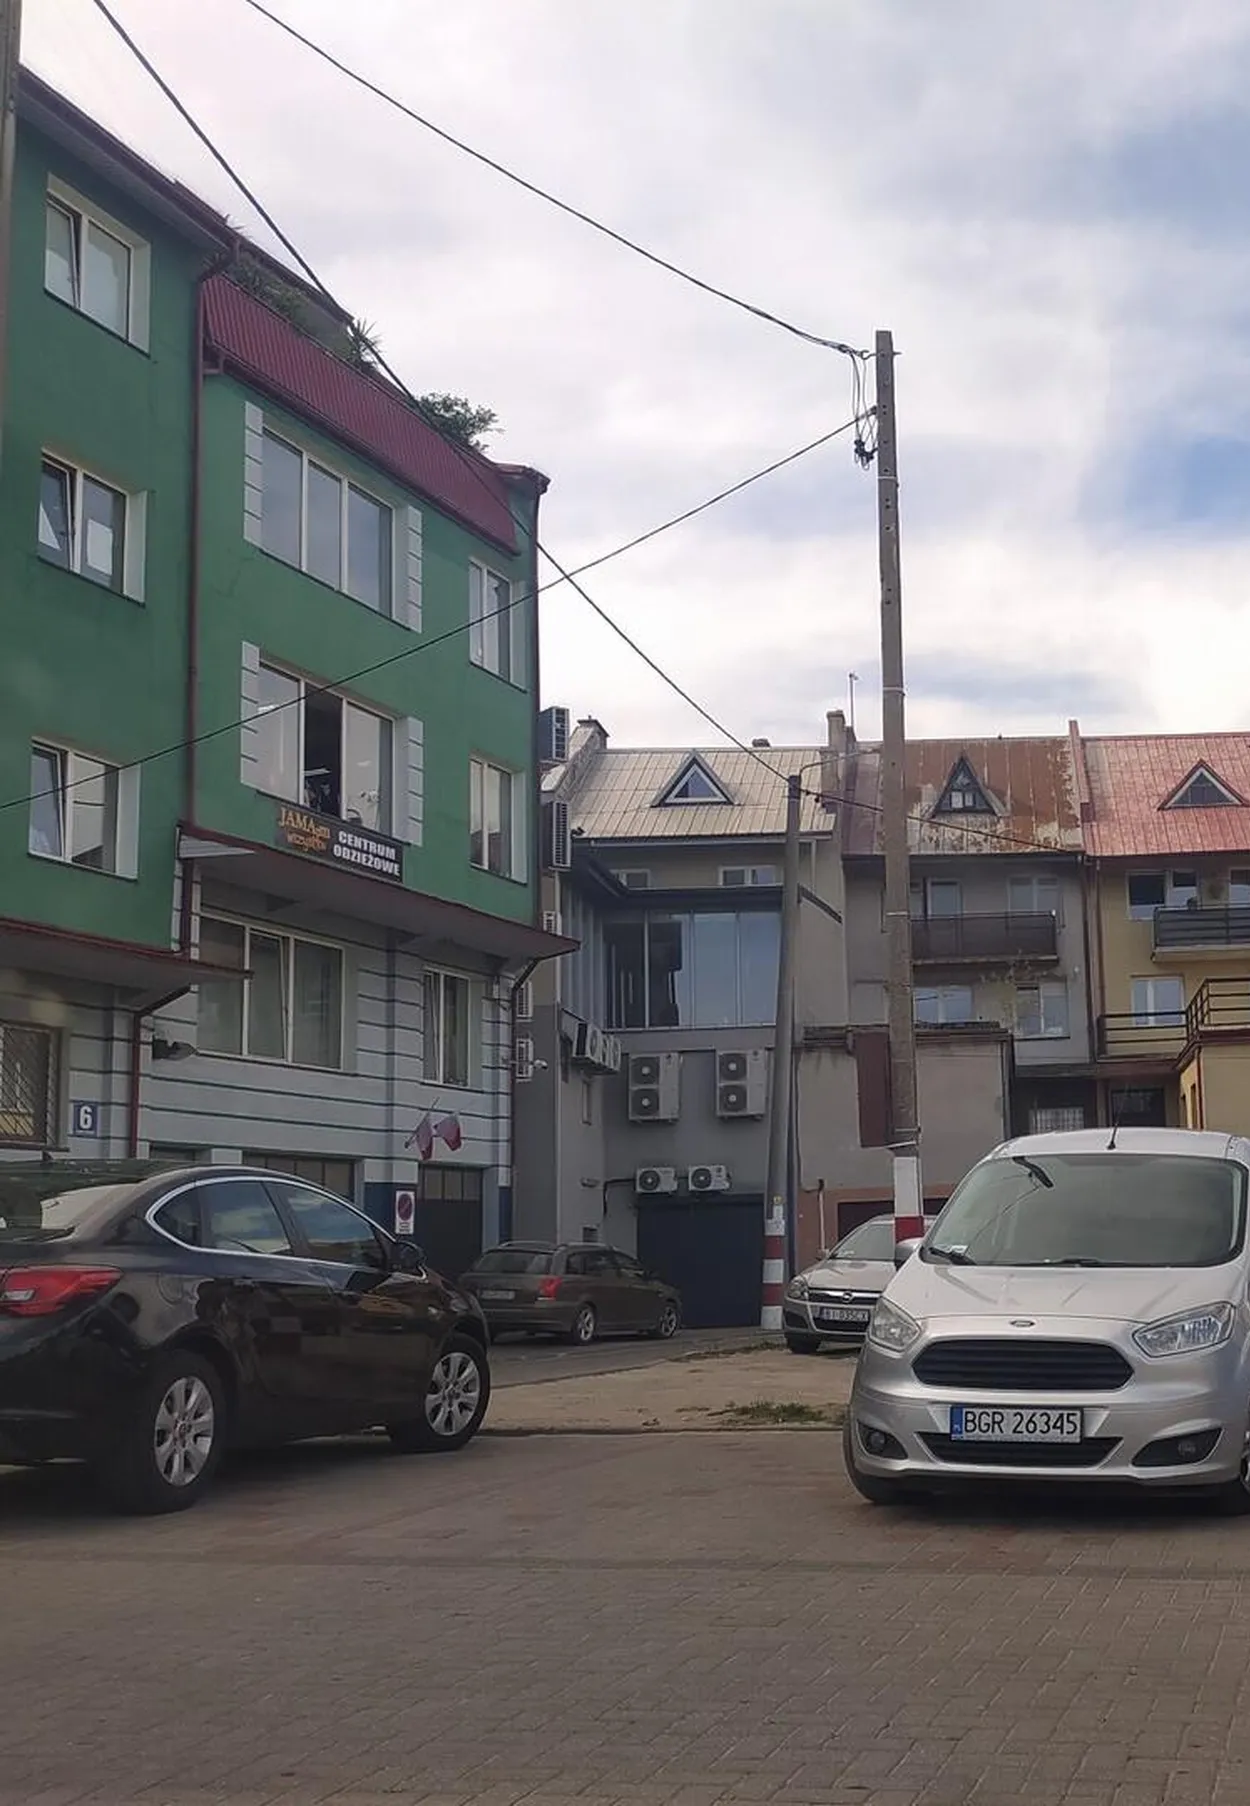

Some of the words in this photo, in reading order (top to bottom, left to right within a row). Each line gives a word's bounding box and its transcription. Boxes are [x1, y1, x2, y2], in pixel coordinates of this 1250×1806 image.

[338, 830, 396, 860] CENTRUM
[80, 1105, 93, 1129] 6
[964, 1410, 1004, 1434] BGR
[1011, 1411, 1078, 1435] 26345
